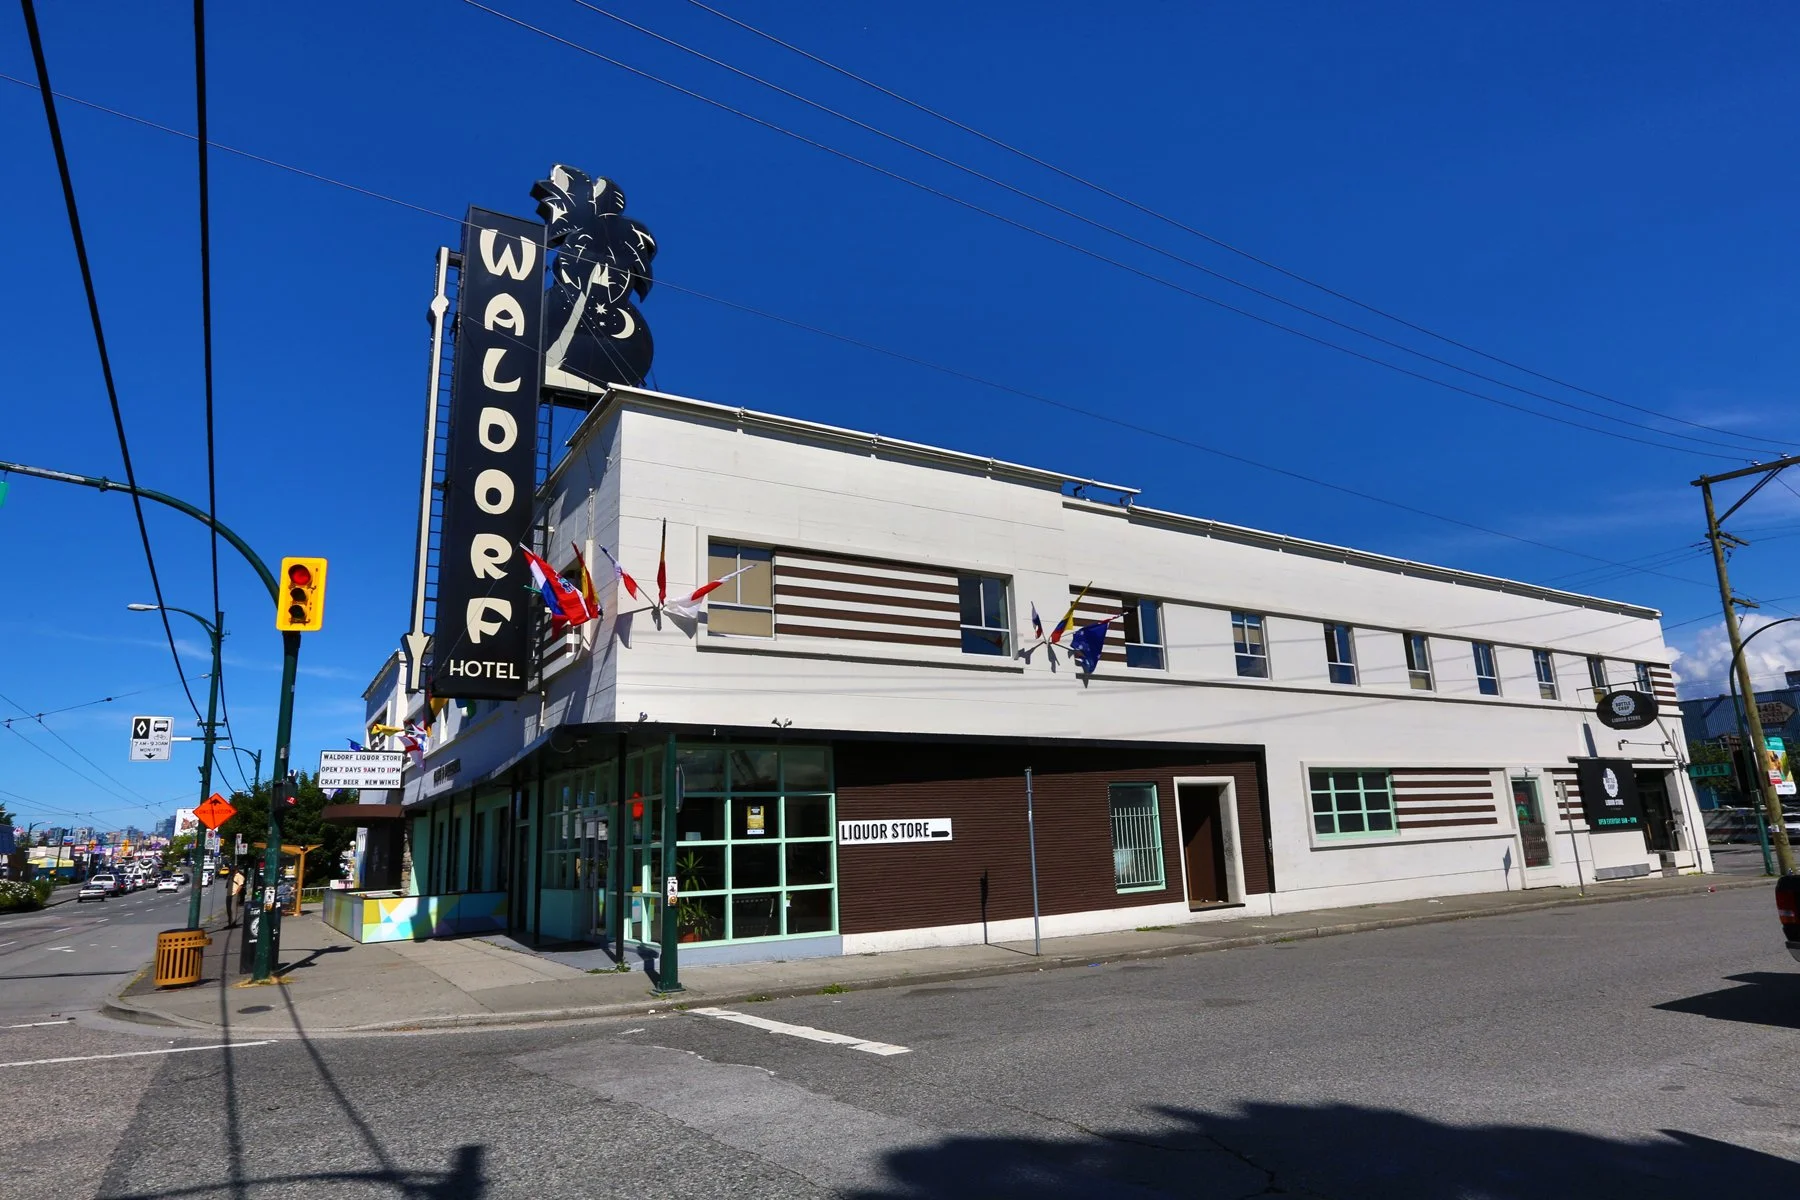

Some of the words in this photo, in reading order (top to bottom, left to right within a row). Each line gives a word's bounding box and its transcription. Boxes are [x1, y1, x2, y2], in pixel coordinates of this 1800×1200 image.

[466, 229, 537, 644] WALDORF
[449, 659, 521, 680] HOTEL
[1695, 764, 1725, 776] OPEN
[841, 823, 888, 841] LIQUOR
[891, 822, 930, 839] STORE
